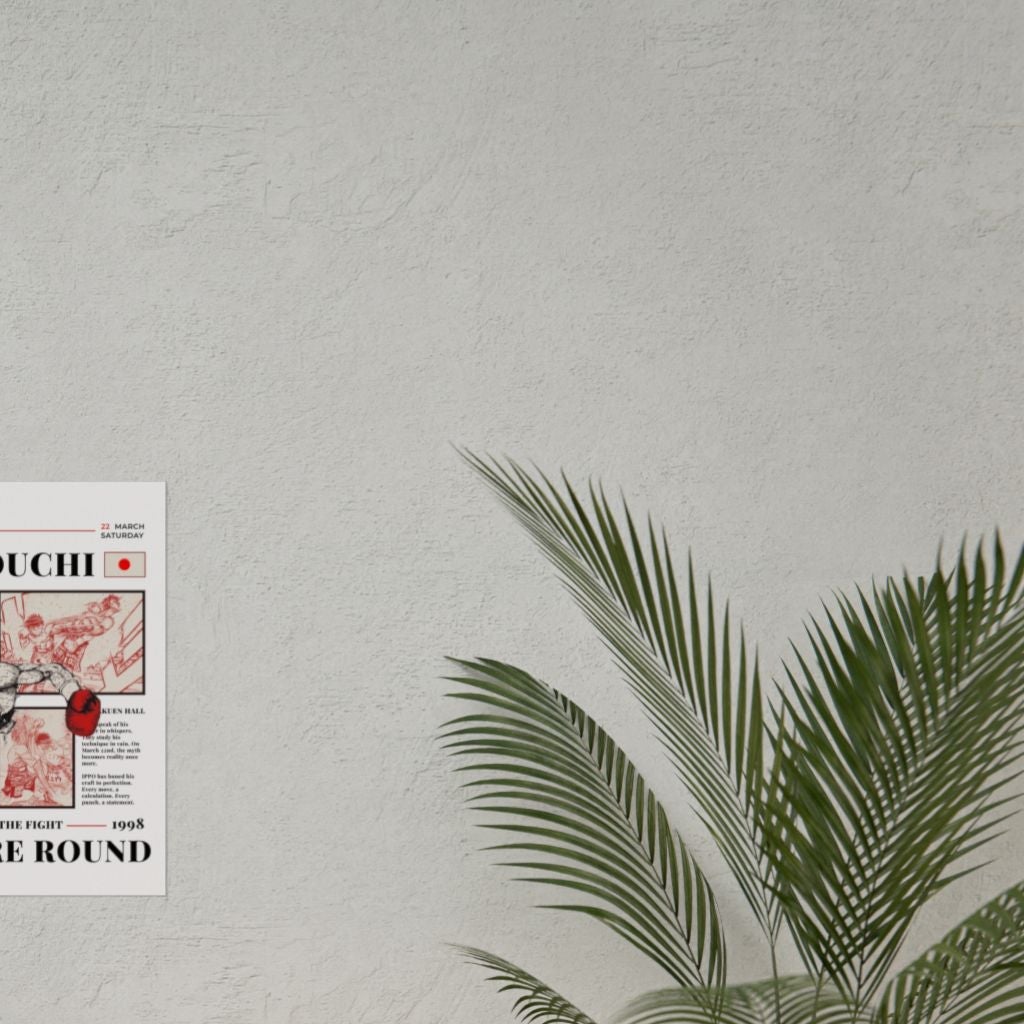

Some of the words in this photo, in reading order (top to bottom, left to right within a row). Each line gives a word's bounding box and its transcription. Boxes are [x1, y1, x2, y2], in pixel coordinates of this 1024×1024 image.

[125, 707, 146, 715] HALL
[26, 820, 64, 830] FIGHT
[112, 818, 145, 831] 1998
[34, 839, 152, 863] ROUND
